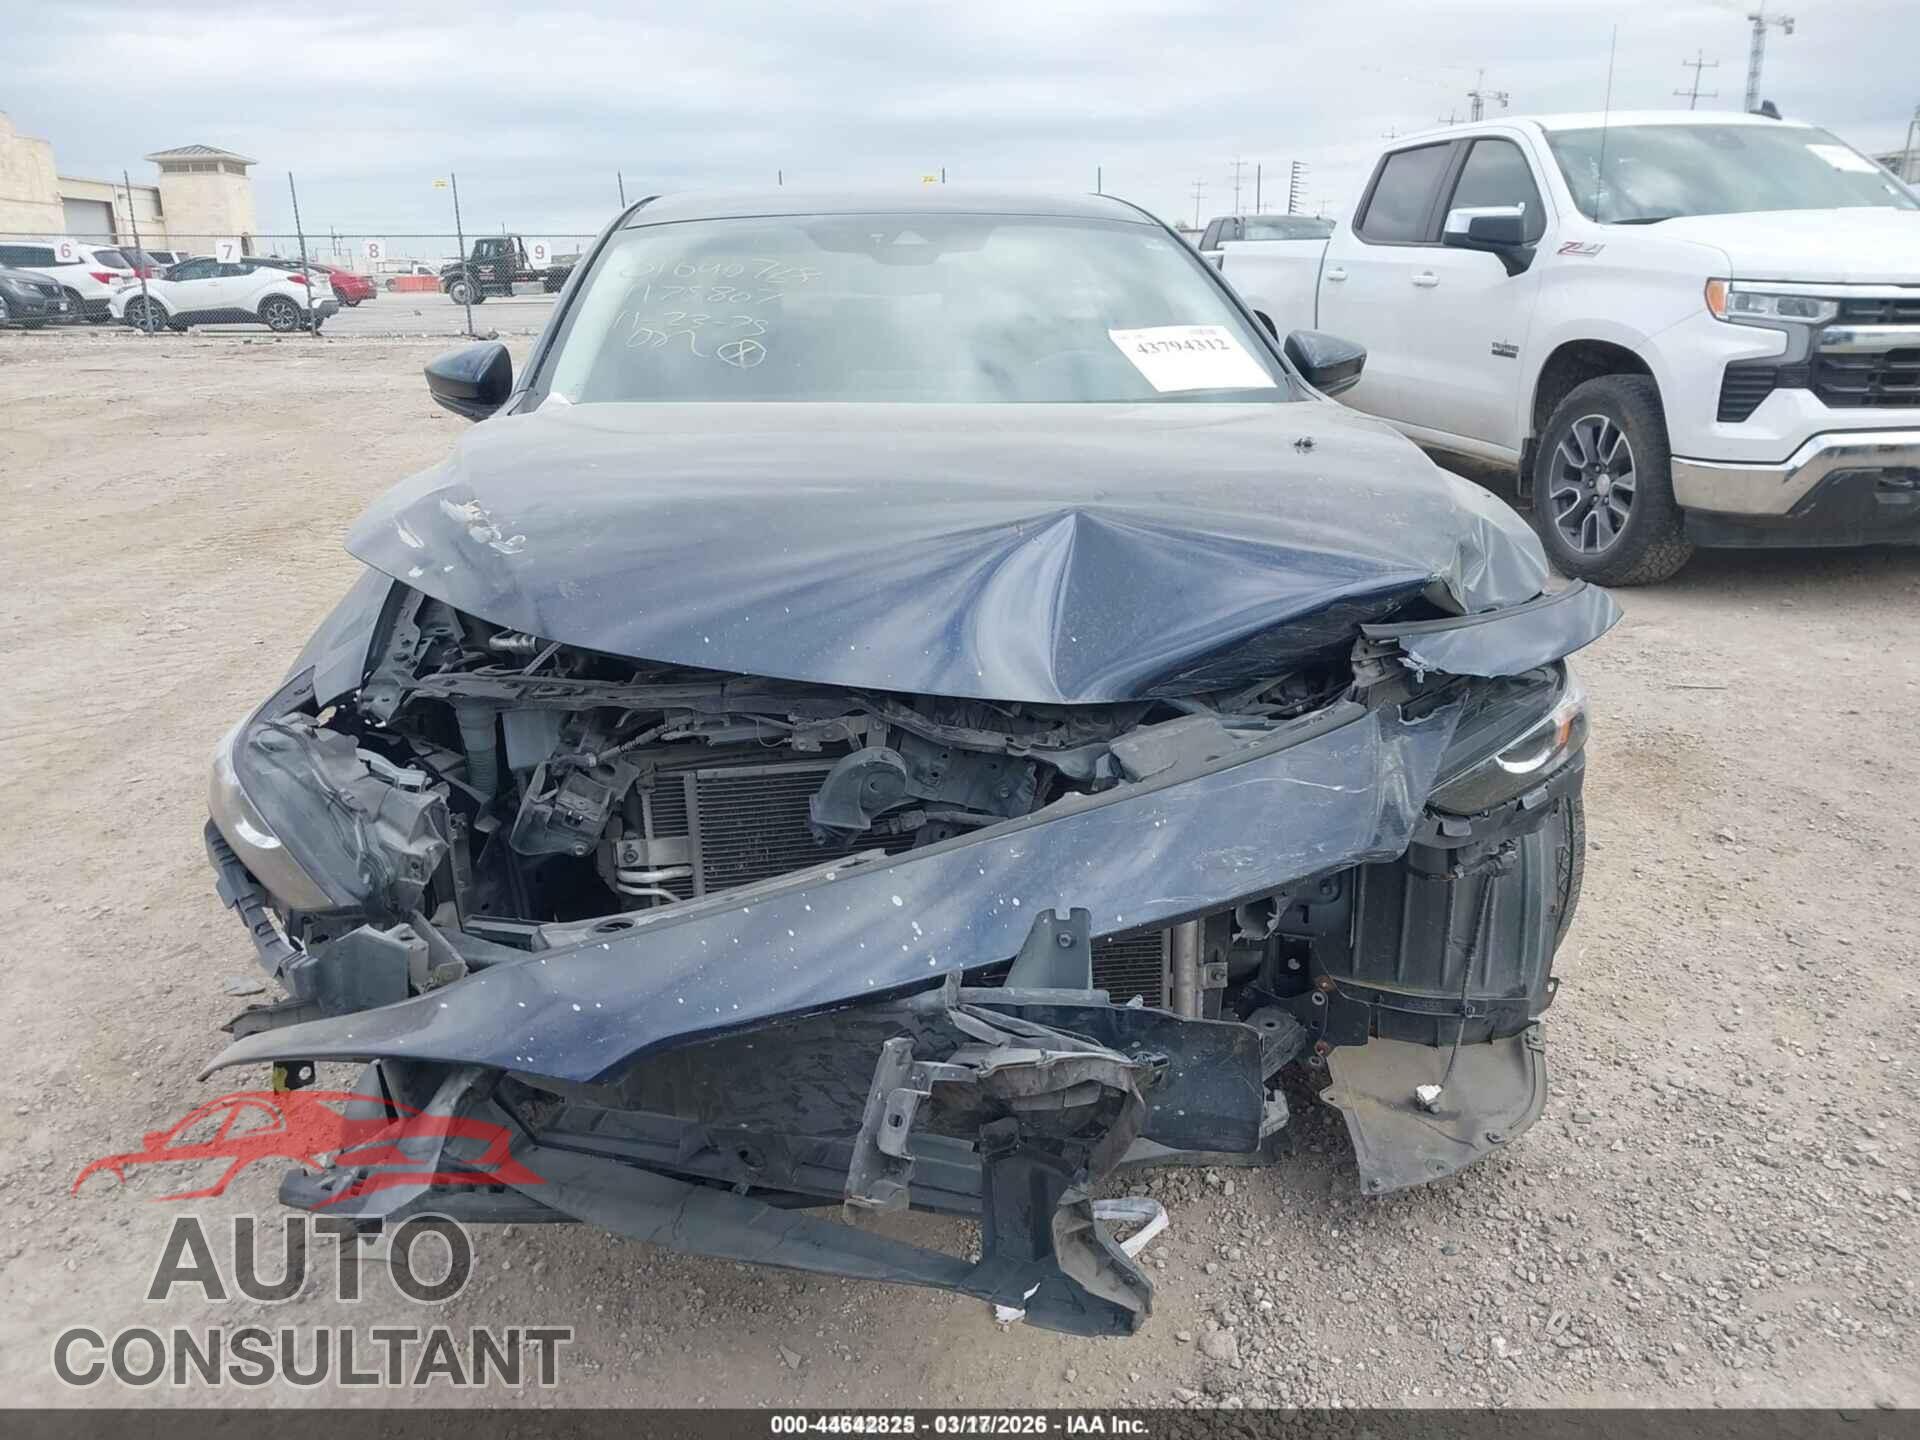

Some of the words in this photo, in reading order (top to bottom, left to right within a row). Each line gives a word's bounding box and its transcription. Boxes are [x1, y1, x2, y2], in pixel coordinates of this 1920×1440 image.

[60, 243, 72, 258] 6
[222, 244, 233, 260] 7
[369, 243, 380, 258] 8
[535, 245, 545, 260] 9
[1136, 337, 1232, 355] 43794312
